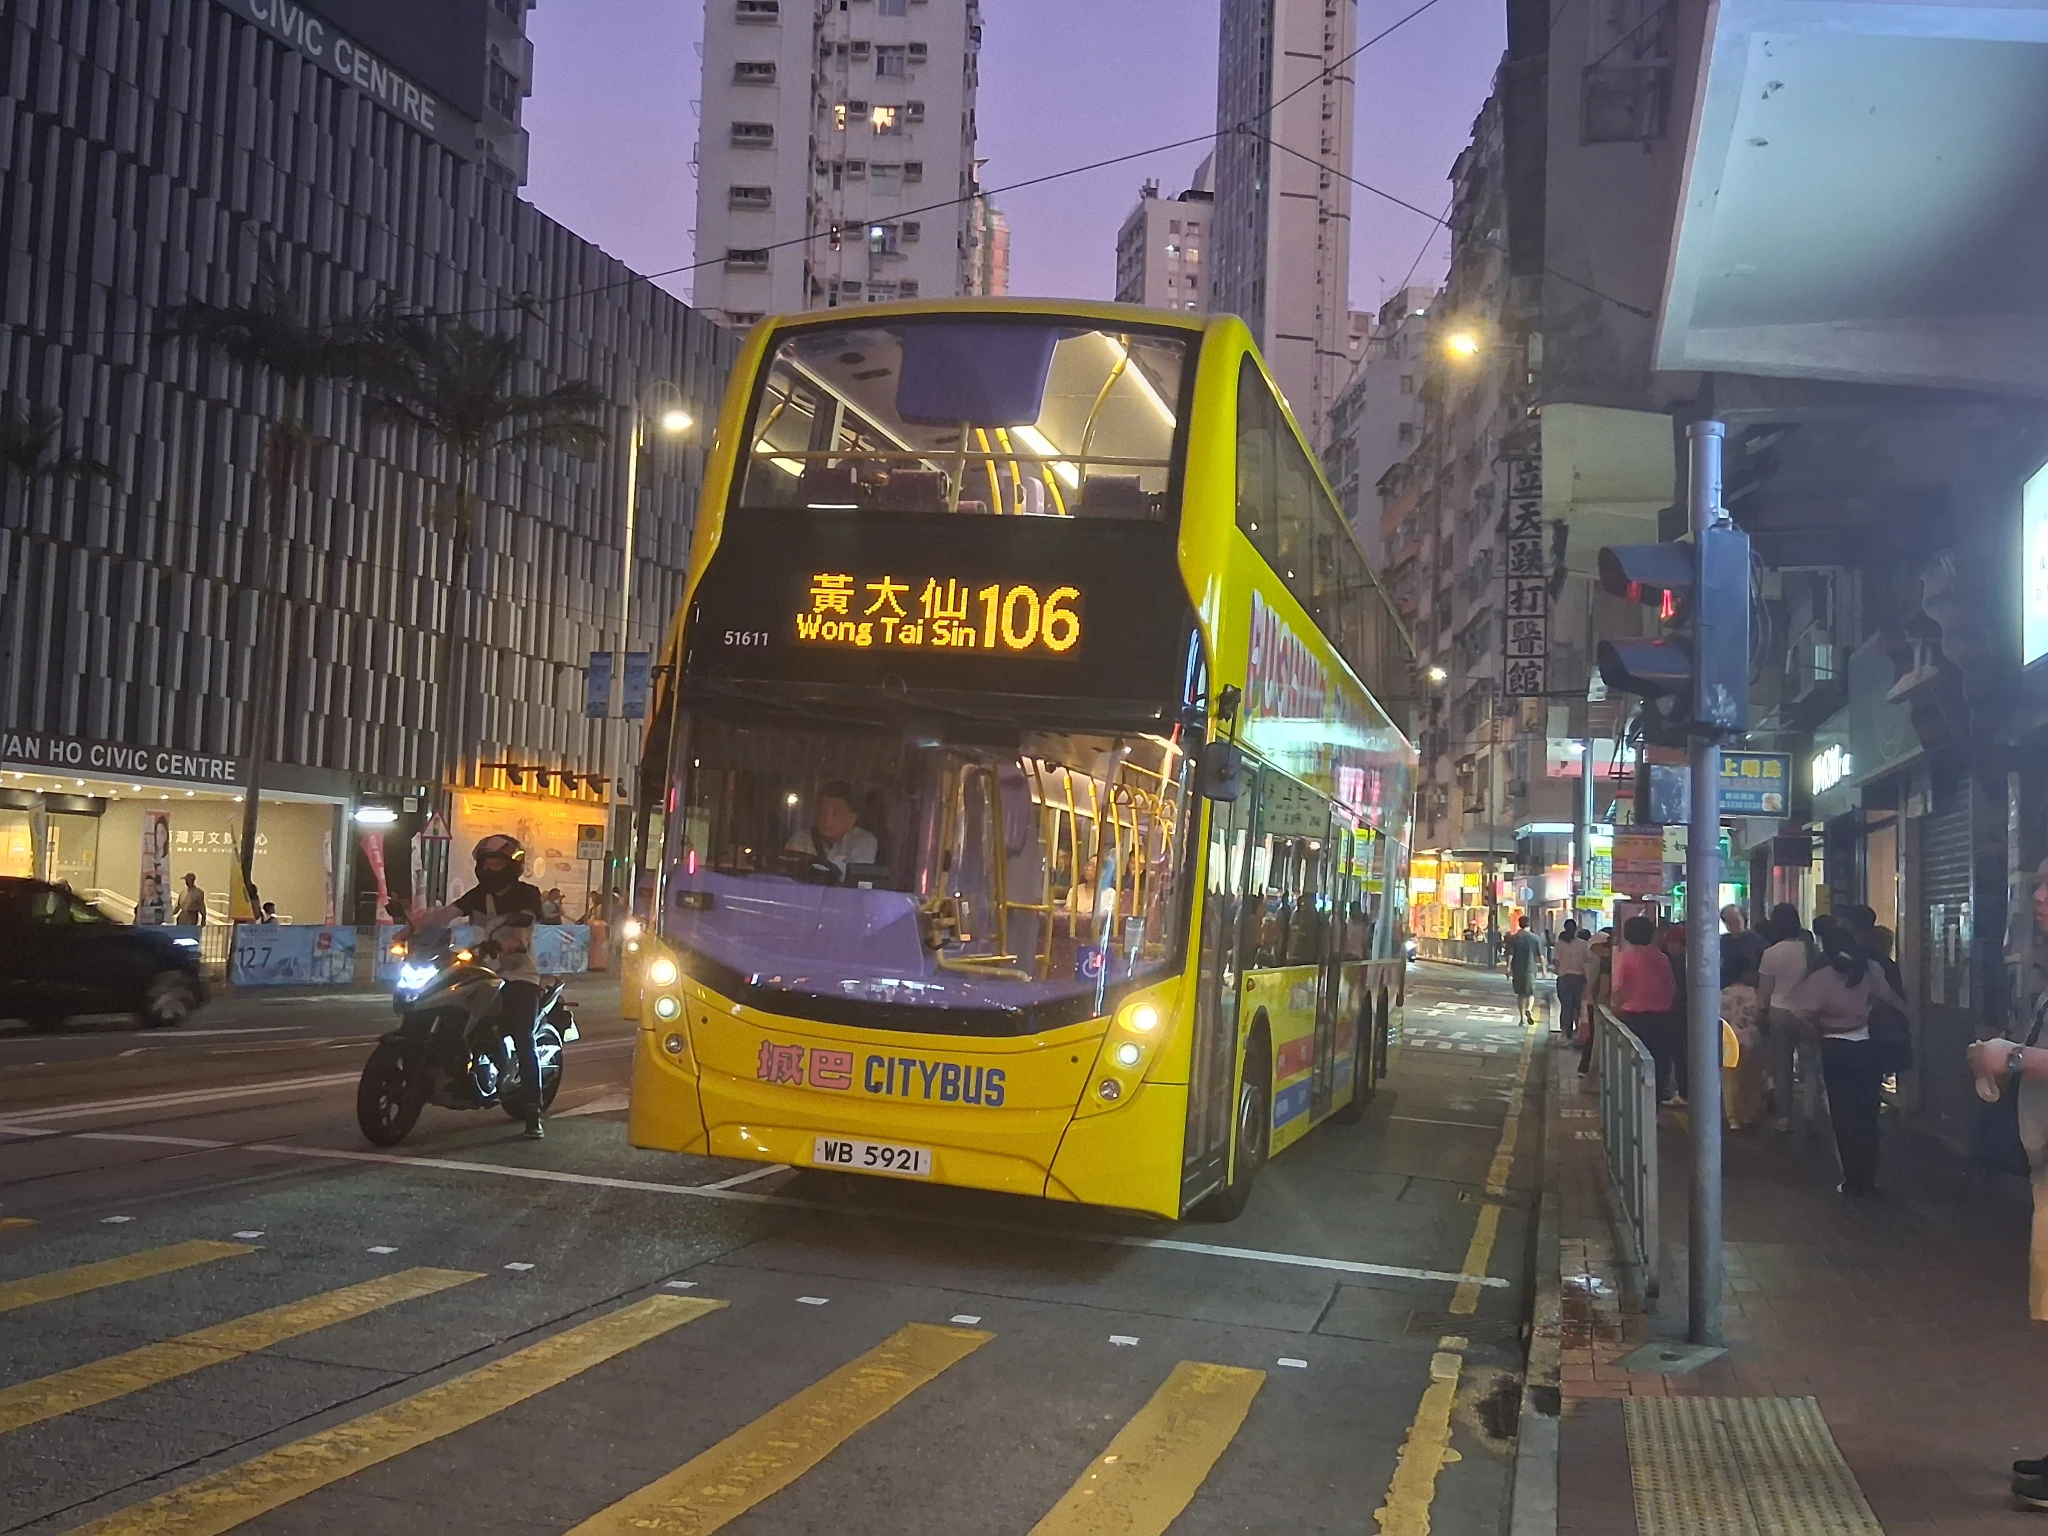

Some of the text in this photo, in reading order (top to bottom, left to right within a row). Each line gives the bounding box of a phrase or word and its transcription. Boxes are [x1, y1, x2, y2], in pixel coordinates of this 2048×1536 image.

[334, 39, 435, 132] CENTRE
[810, 573, 969, 620] 黃大仙
[979, 584, 1080, 651] 106
[724, 630, 769, 646] 51611
[796, 613, 976, 647] Wong Tai Sin
[2, 734, 236, 780] AN HO CIVIC CENTRE
[757, 1039, 1006, 1107] 城巴 CITYBUS
[824, 1140, 919, 1171] WB 5921
